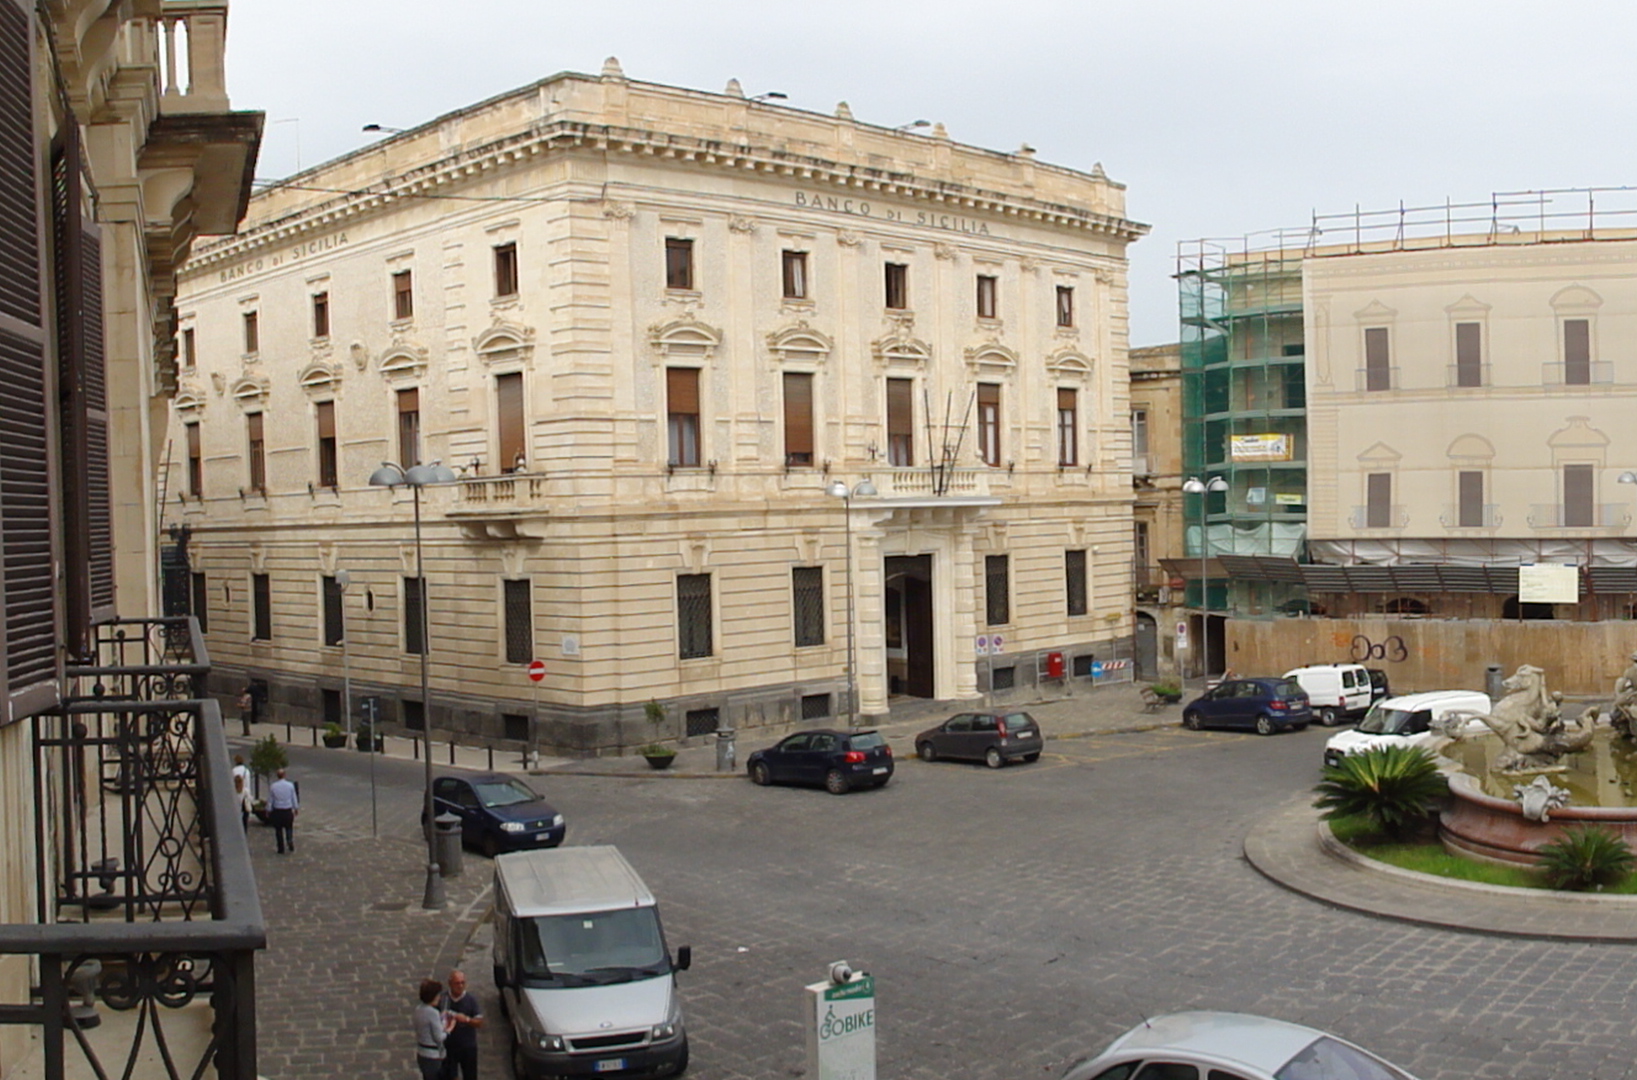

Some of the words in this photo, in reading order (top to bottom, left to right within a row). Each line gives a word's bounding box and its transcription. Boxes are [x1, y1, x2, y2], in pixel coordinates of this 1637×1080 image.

[796, 191, 871, 216] BANCO
[917, 211, 990, 235] SICILIA
[220, 260, 264, 283] BANCO
[293, 232, 349, 260] SICILIA
[820, 1009, 874, 1040] GOBIKE
